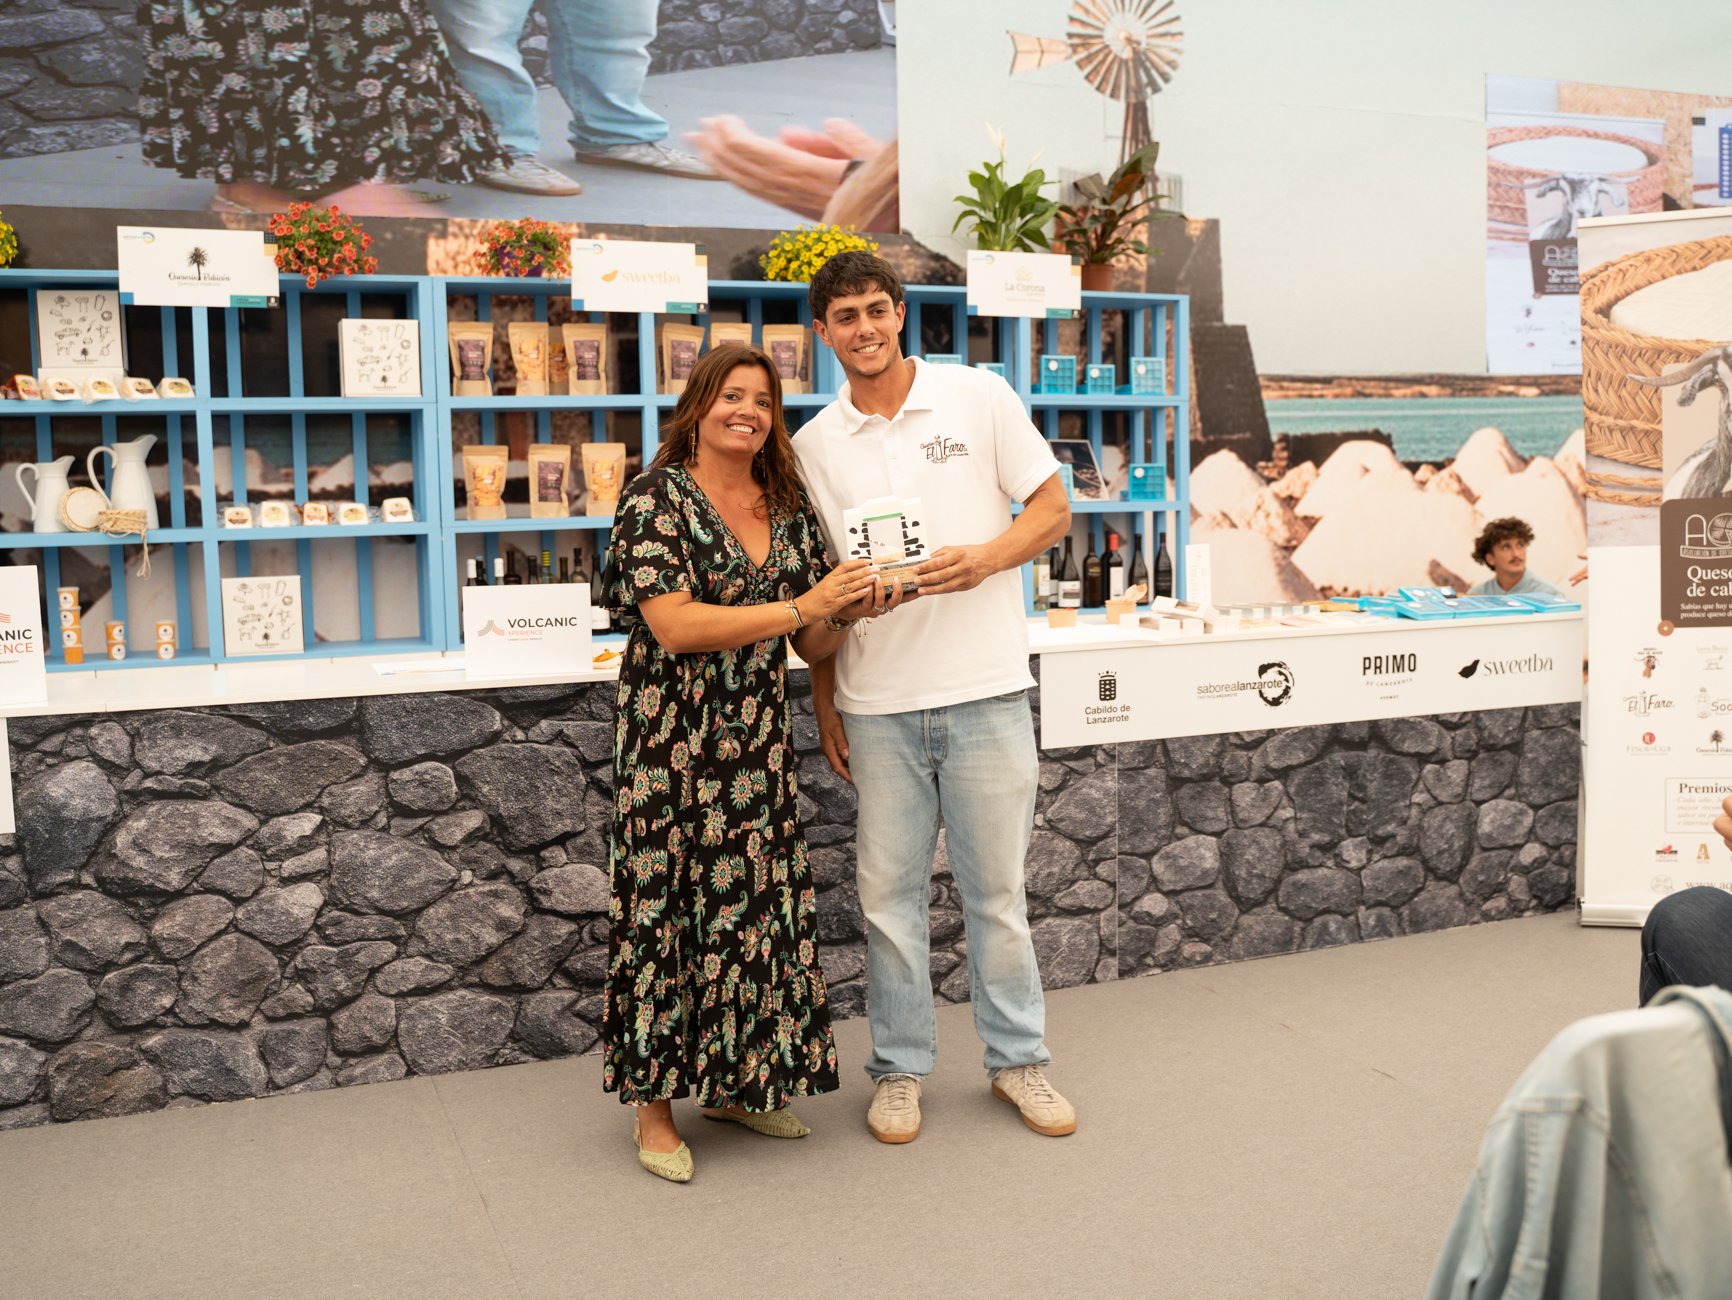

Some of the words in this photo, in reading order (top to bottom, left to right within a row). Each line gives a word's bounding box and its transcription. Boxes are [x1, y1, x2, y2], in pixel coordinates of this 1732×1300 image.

[622, 270, 680, 284] sweetba
[1004, 282, 1014, 291] La
[1016, 282, 1046, 292] Corona
[943, 437, 966, 456] Faro
[1686, 582, 1706, 598] de
[1702, 603, 1715, 612] que
[1716, 602, 1728, 612] hay
[508, 616, 577, 628] VOLCANIC
[1680, 611, 1706, 620] produce
[1707, 611, 1726, 620] queso
[1362, 653, 1417, 676] PRIMO
[1483, 653, 1554, 677] sweetba
[1196, 678, 1284, 695] saborealanzarote
[1648, 693, 1672, 710] Faro
[1084, 705, 1118, 715] Cabildo
[1119, 704, 1131, 713] de
[1086, 714, 1130, 725] Lanzarote
